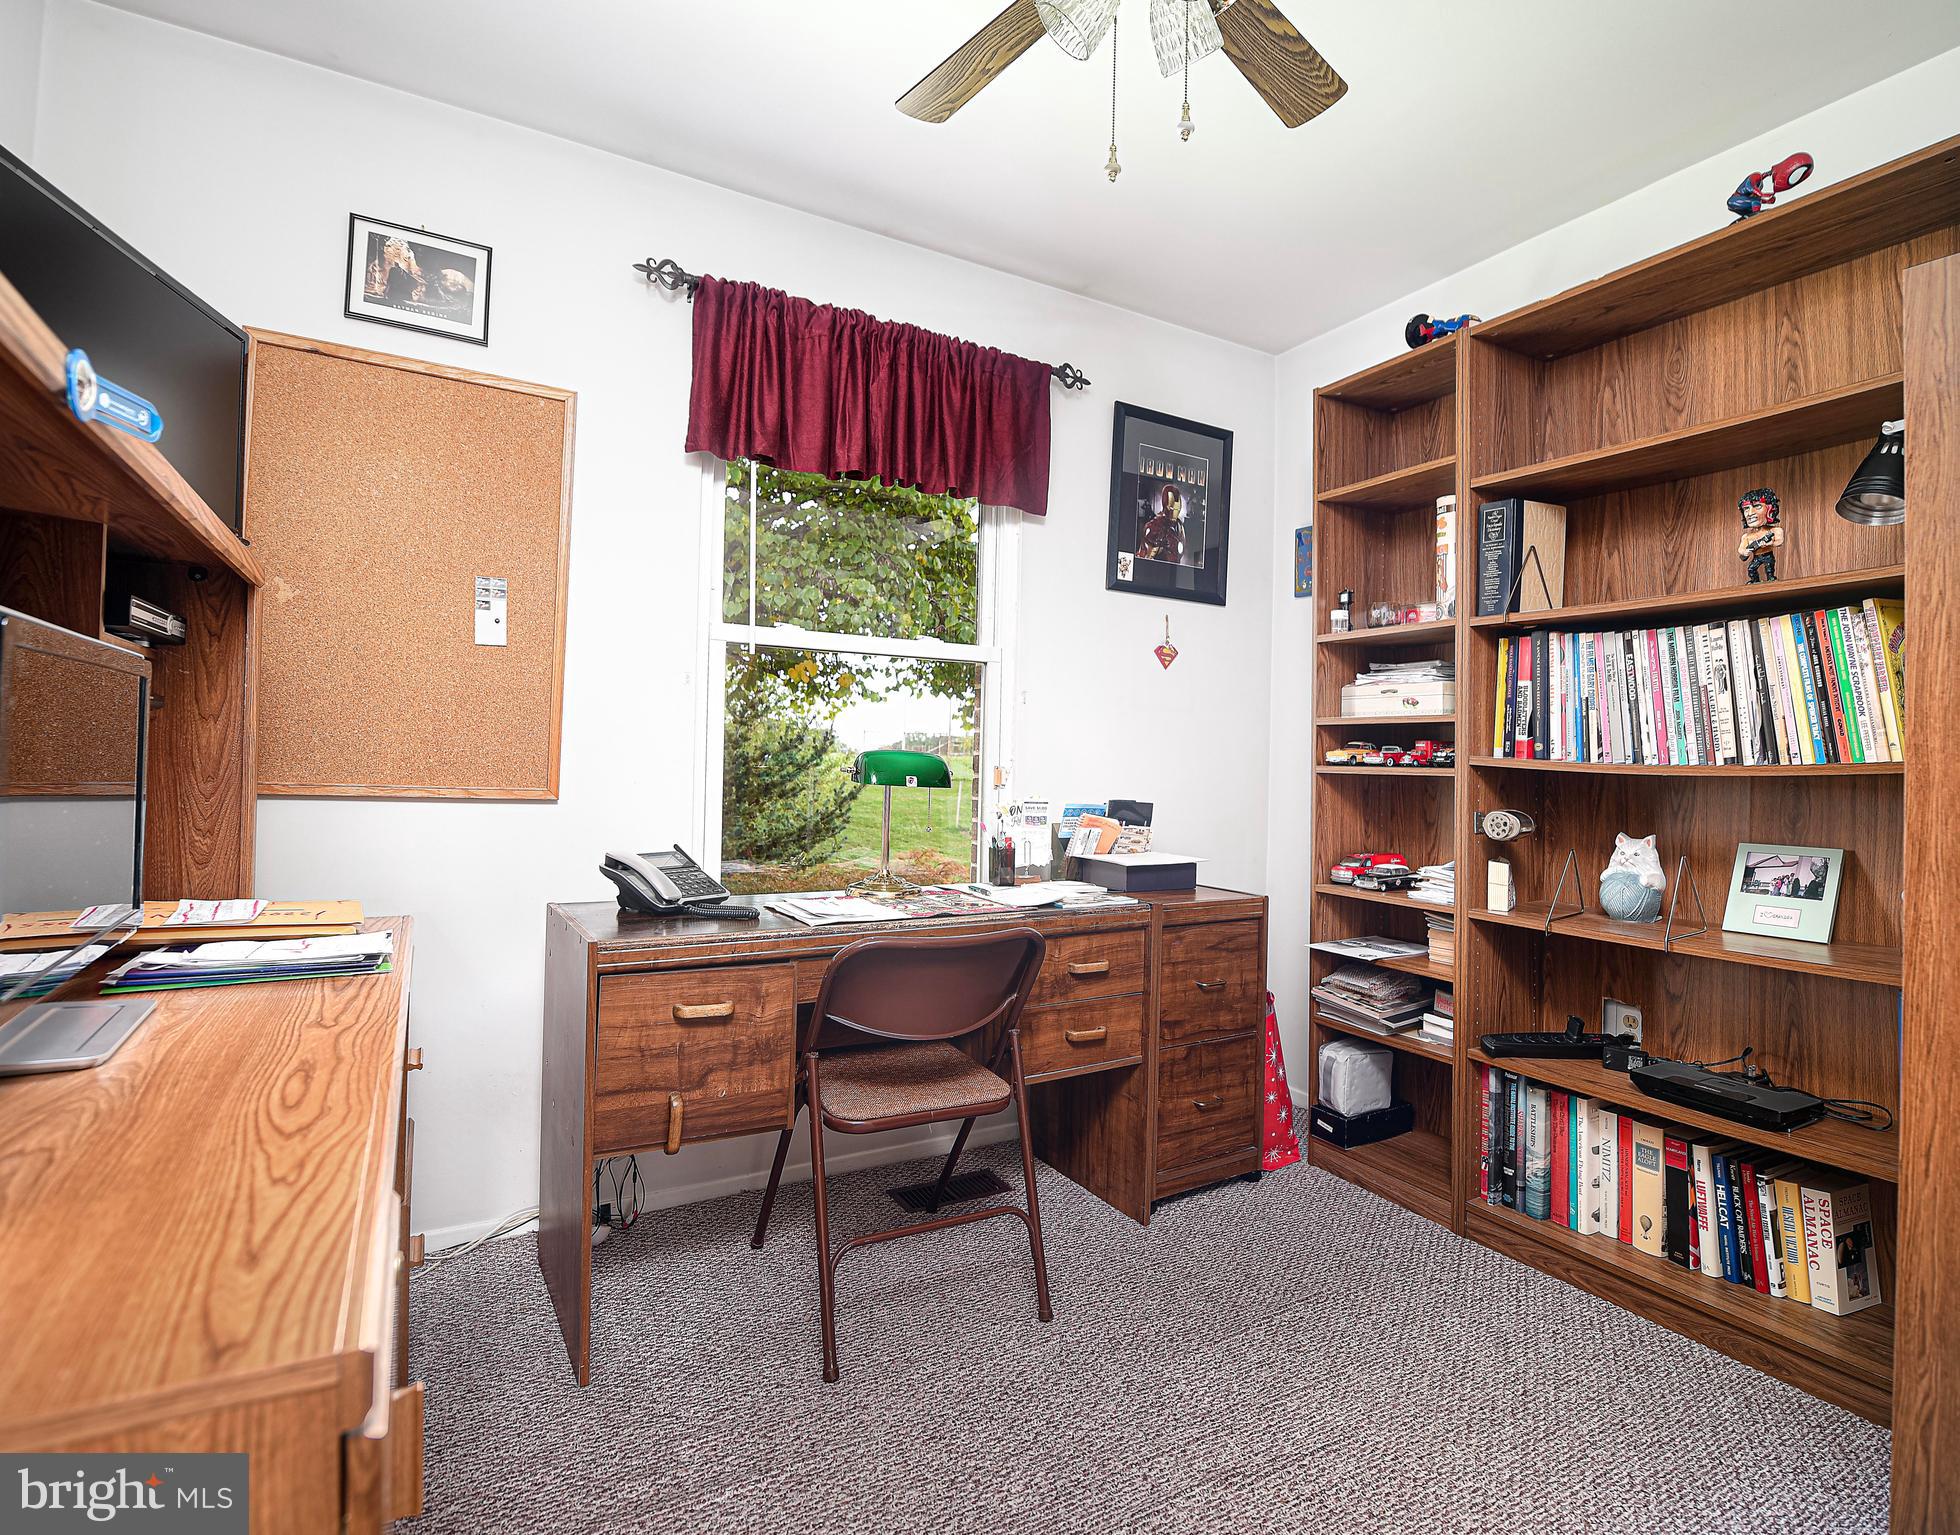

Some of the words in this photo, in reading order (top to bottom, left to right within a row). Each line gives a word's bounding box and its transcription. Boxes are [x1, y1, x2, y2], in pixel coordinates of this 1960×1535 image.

[1140, 457, 1173, 479] IRON
[1178, 465, 1205, 486] MAN
[1839, 608, 1848, 622] THE
[1586, 641, 1594, 650] THE
[1842, 623, 1851, 643] JOHN
[1799, 652, 1809, 678] COMPLETE
[1846, 644, 1856, 670] WAYNE
[1587, 674, 1595, 688] GARY
[1626, 653, 1636, 701] EASTWOOD
[1668, 643, 1676, 665] MODERN
[1672, 689, 1680, 702] FILM
[1803, 679, 1812, 693] FILMS
[1850, 671, 1866, 717] SCRAPBOOK
[1682, 692, 1692, 734] HOLLYWOOD
[1807, 702, 1817, 723] SPENCER
[1811, 723, 1820, 740] TRACY
[1602, 1137, 1611, 1183] NIMITZ
[1637, 1152, 1656, 1161] EAGLE
[1637, 1158, 1656, 1166] ALOFT
[1696, 1180, 1708, 1232] LUFTWAFFE
[1716, 1184, 1729, 1230] HELLCAT
[1732, 1185, 1741, 1208] BLACK
[1840, 1192, 1861, 1205] SPACE
[1735, 1209, 1743, 1224] CAT
[1782, 1207, 1796, 1232] DESERT
[1818, 1198, 1832, 1249] SPACE
[1834, 1203, 1868, 1219] ALMANAC
[1737, 1225, 1747, 1255] RAIDERS
[1803, 1193, 1820, 1270] ALMANAC
[1785, 1236, 1799, 1265] VICTORY
